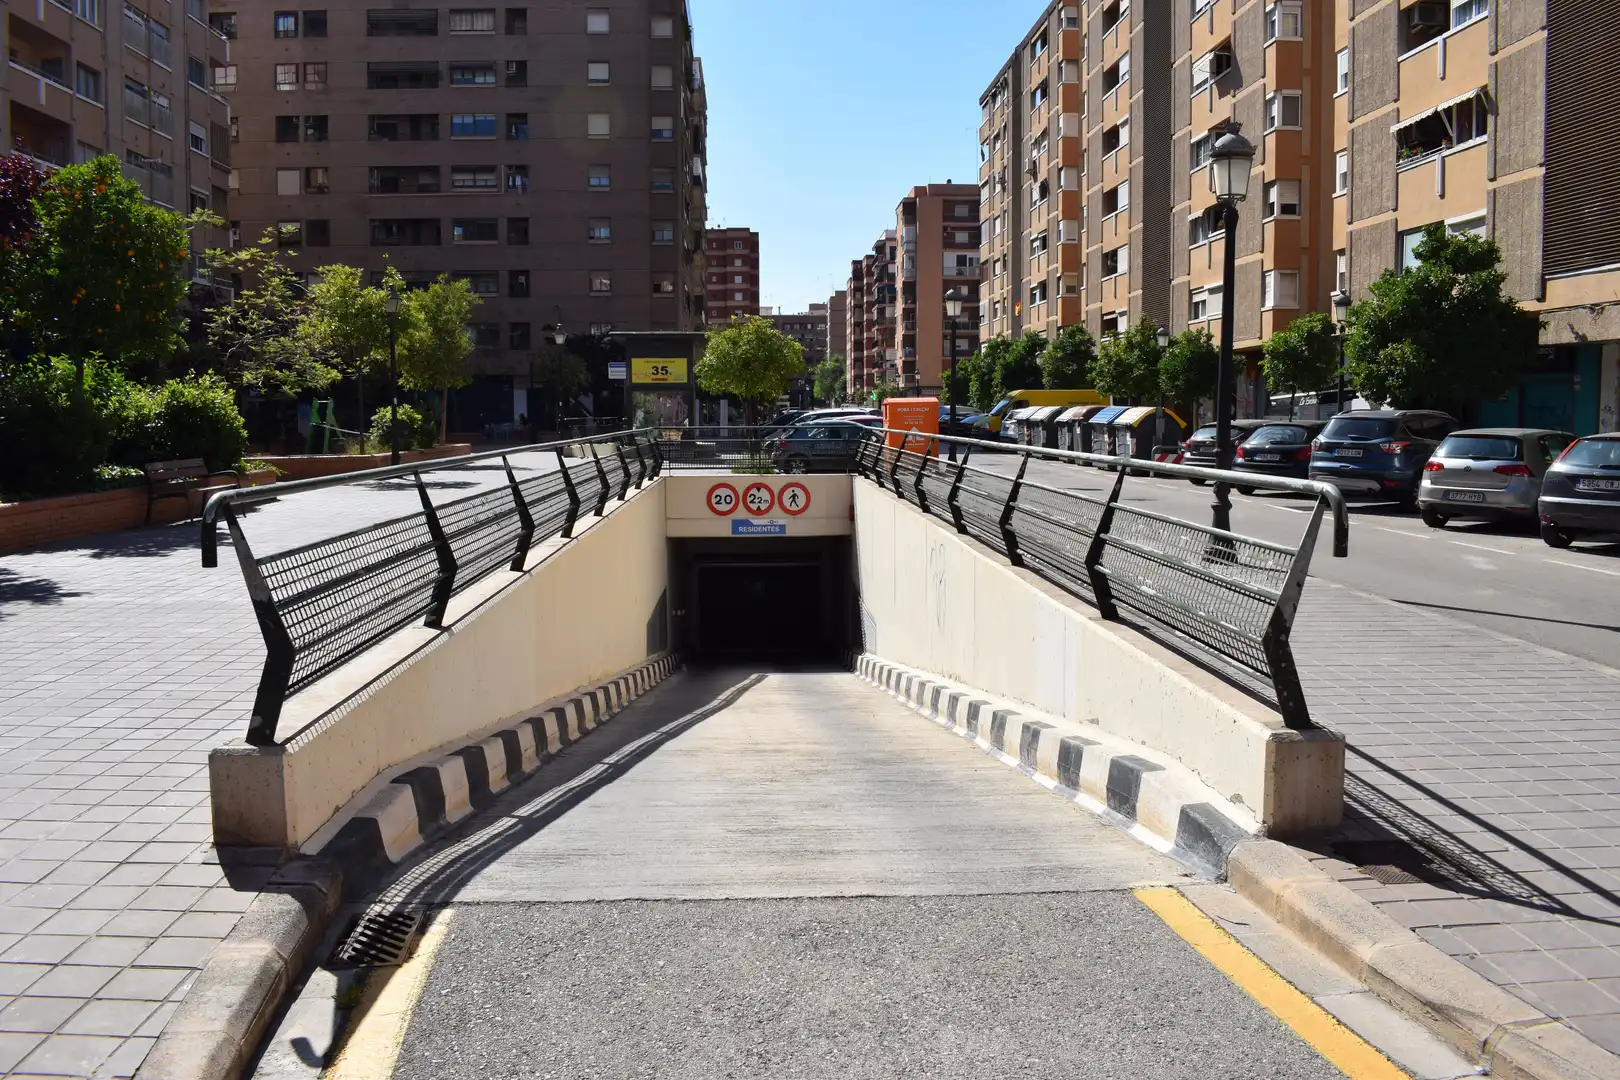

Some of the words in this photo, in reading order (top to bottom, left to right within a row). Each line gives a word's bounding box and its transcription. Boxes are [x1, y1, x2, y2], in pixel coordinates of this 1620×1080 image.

[651, 365, 669, 376] 35
[714, 494, 733, 505] 20
[738, 525, 780, 533] RESIDENTES
